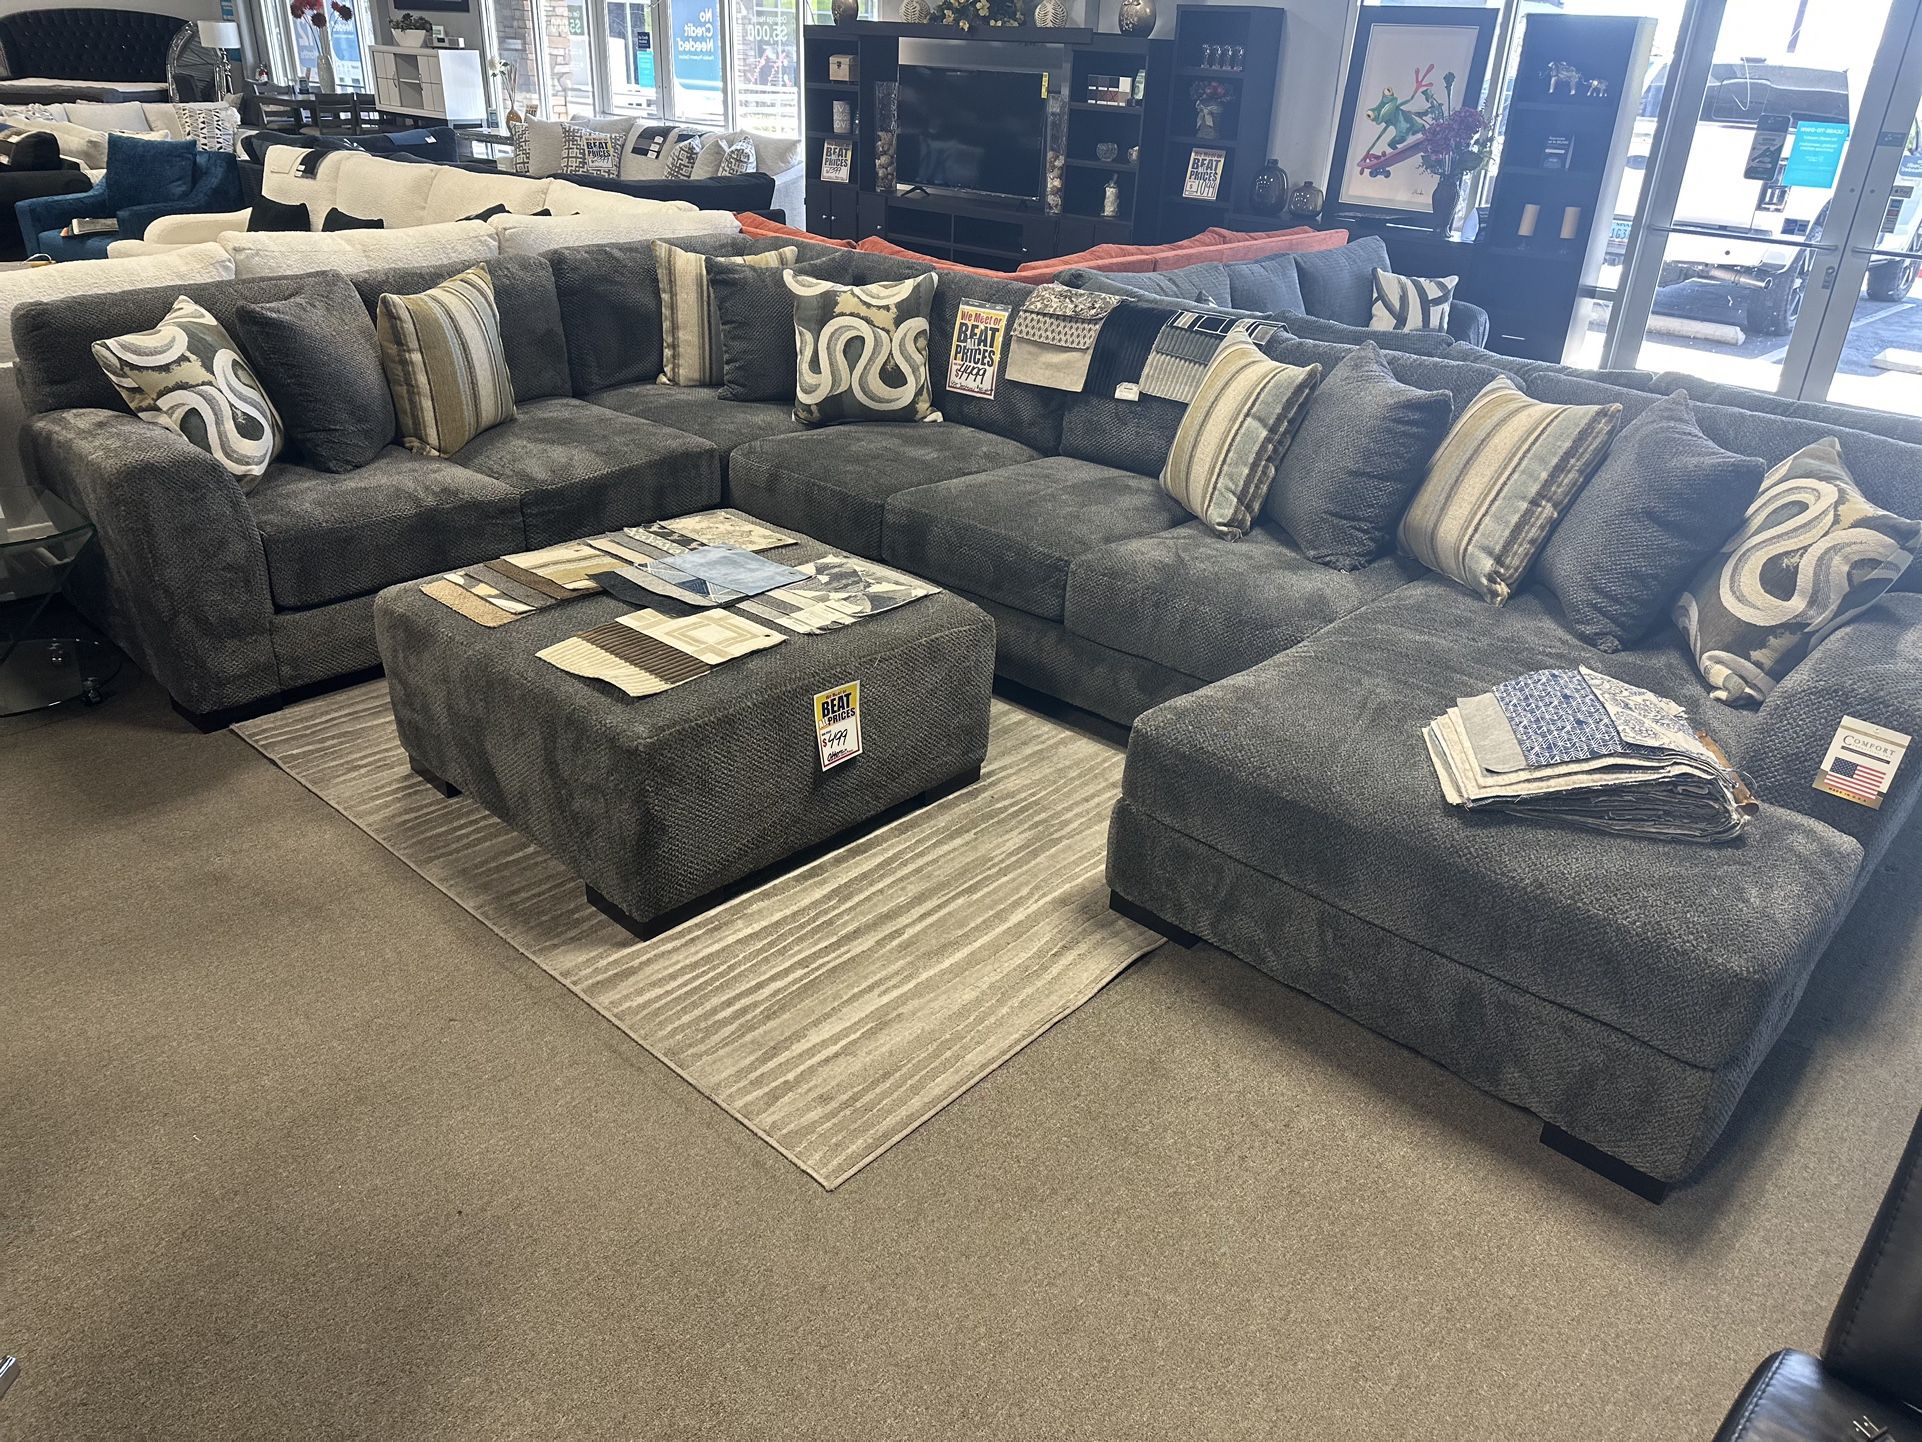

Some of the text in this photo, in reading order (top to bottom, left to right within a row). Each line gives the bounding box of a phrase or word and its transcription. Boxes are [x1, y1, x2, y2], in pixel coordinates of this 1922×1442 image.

[826, 147, 850, 159] BEAT
[824, 158, 848, 167] PRICES
[1192, 158, 1221, 172] BEAT
[1189, 170, 1218, 182] PRICES
[961, 310, 1002, 327] We Meet or
[957, 321, 1000, 349] BEAT
[954, 343, 996, 368] PRICES
[822, 692, 852, 719] BEAT
[828, 707, 856, 725] PRICES
